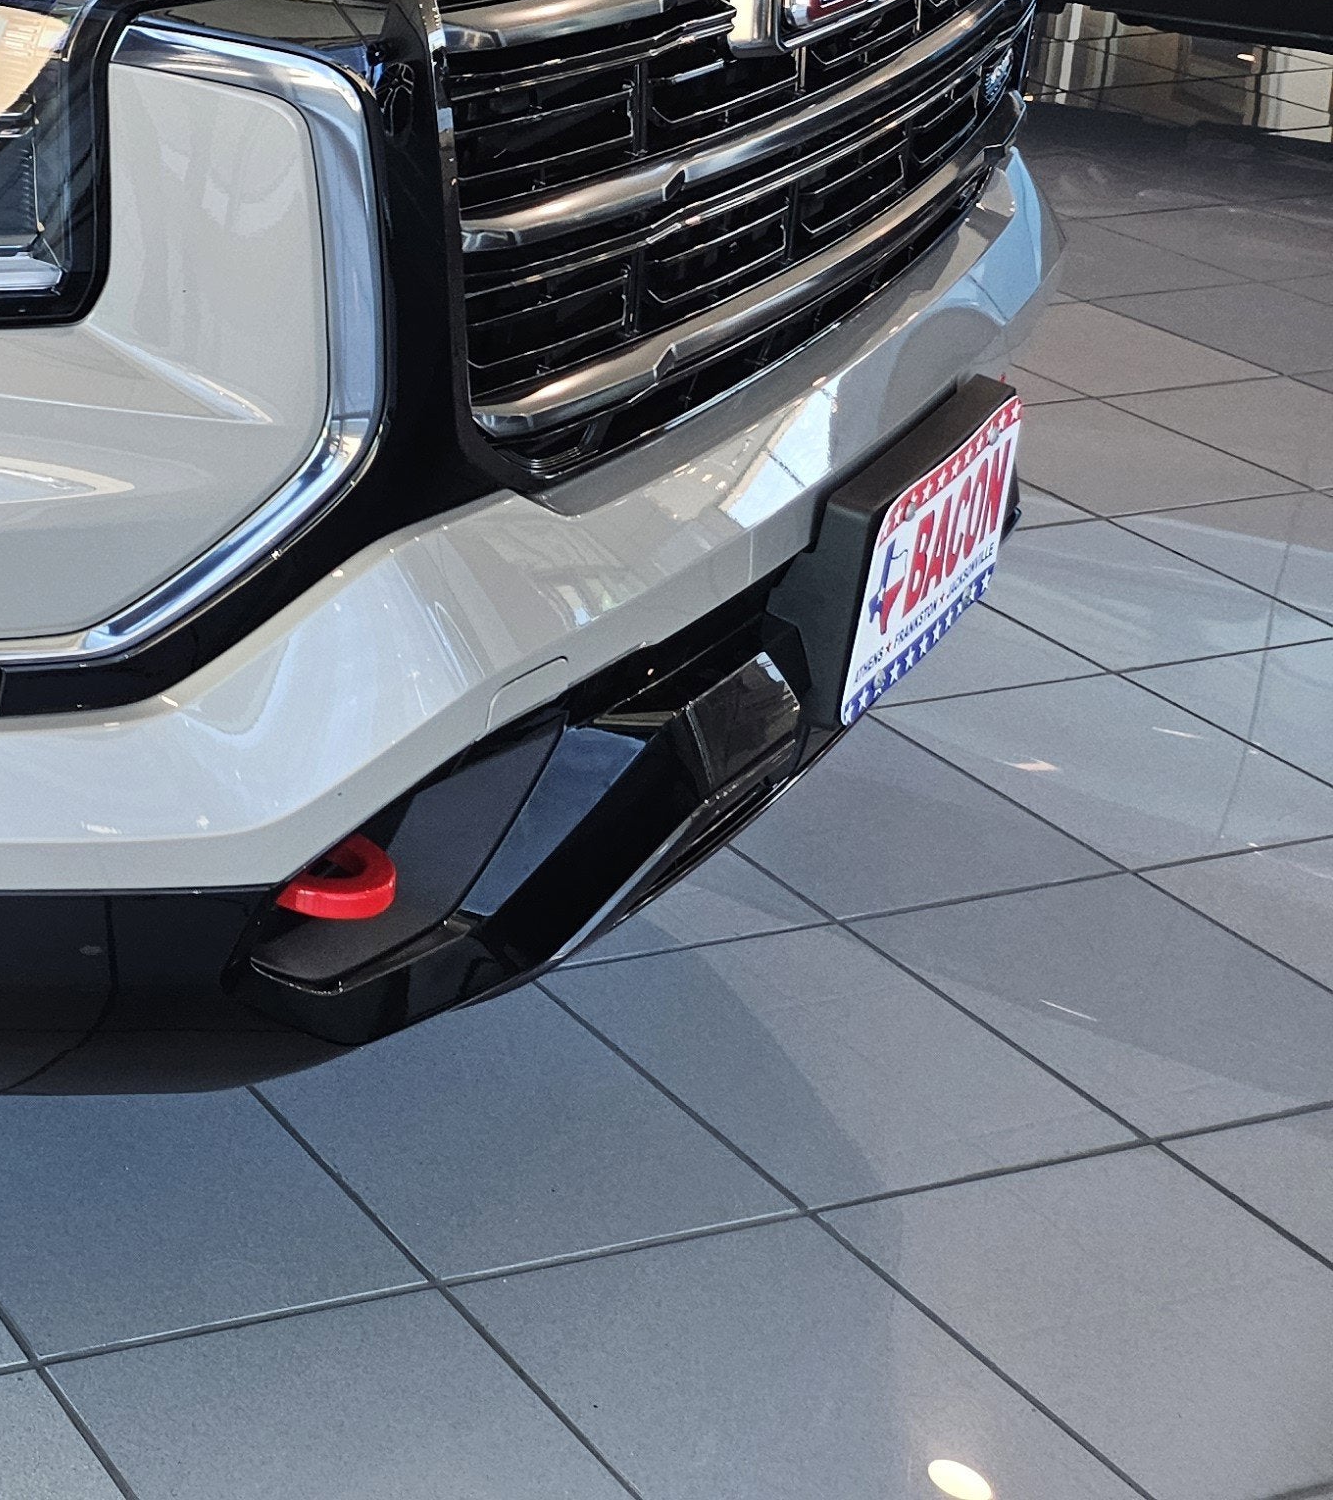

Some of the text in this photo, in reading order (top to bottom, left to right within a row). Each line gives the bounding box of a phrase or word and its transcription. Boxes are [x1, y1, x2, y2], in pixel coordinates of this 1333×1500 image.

[893, 599, 938, 649] FRANKSTON
[946, 541, 995, 600] JACKSONVILLE
[901, 437, 1013, 619] BACON
